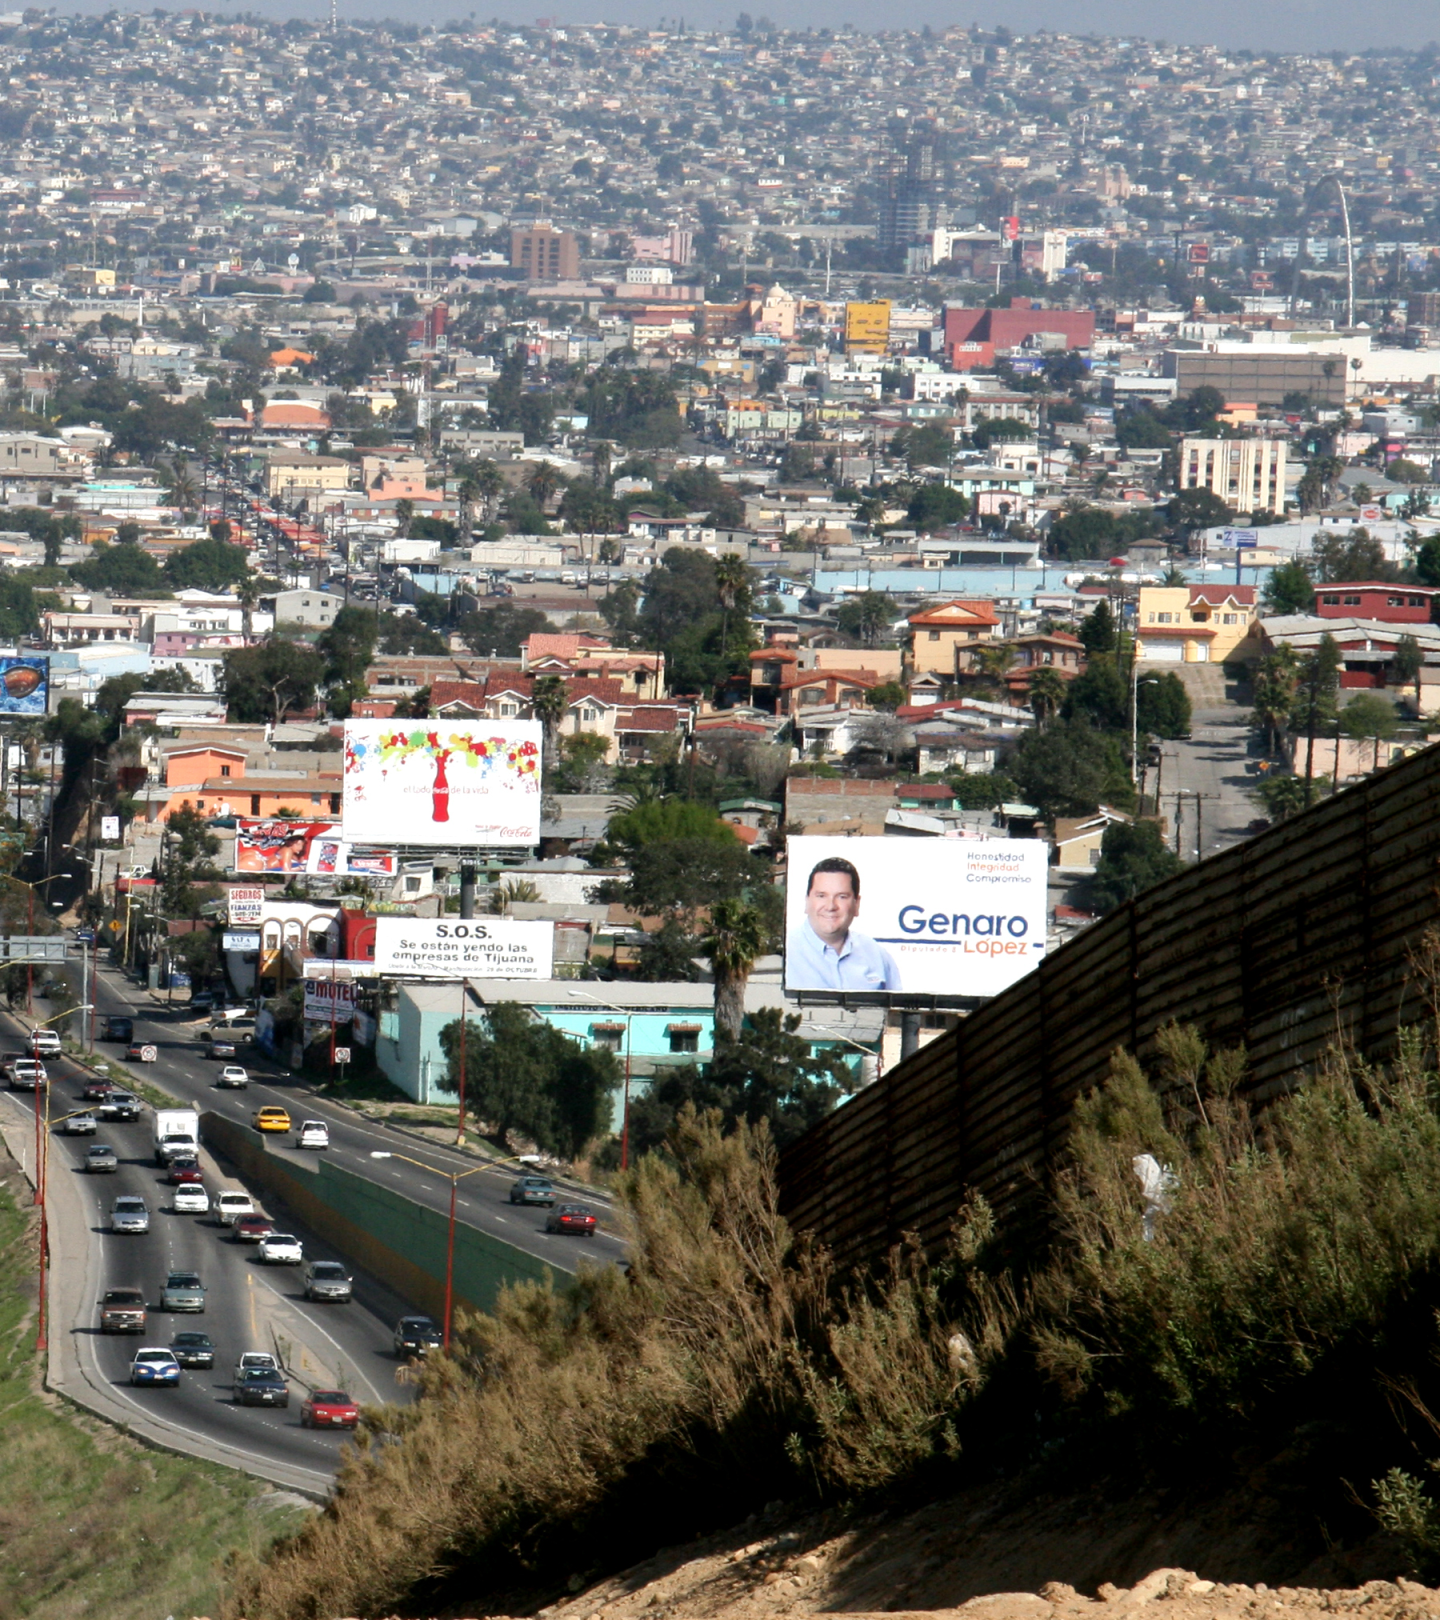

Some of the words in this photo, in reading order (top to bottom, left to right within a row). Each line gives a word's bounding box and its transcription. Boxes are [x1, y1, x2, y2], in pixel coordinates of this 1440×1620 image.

[413, 786, 431, 794] lado
[451, 785, 461, 794] de
[463, 785, 471, 794] la
[473, 785, 489, 794] vida
[500, 826, 534, 837] Coca-Cola
[967, 852, 1025, 861] Honestidad
[967, 862, 1019, 873] Integridad
[966, 873, 1032, 884] Compromiso
[231, 889, 262, 900] SEGUROS
[898, 905, 1028, 937] Genaro
[436, 924, 492, 939] S.O.S.
[400, 939, 417, 949] Se
[421, 940, 459, 951] están
[463, 943, 503, 953] yendo
[508, 943, 527, 953] las
[963, 938, 1028, 958] López
[392, 951, 459, 962] empresas
[463, 952, 480, 962] de
[485, 953, 534, 965] Tijuana
[316, 982, 358, 1002] MOTEL
